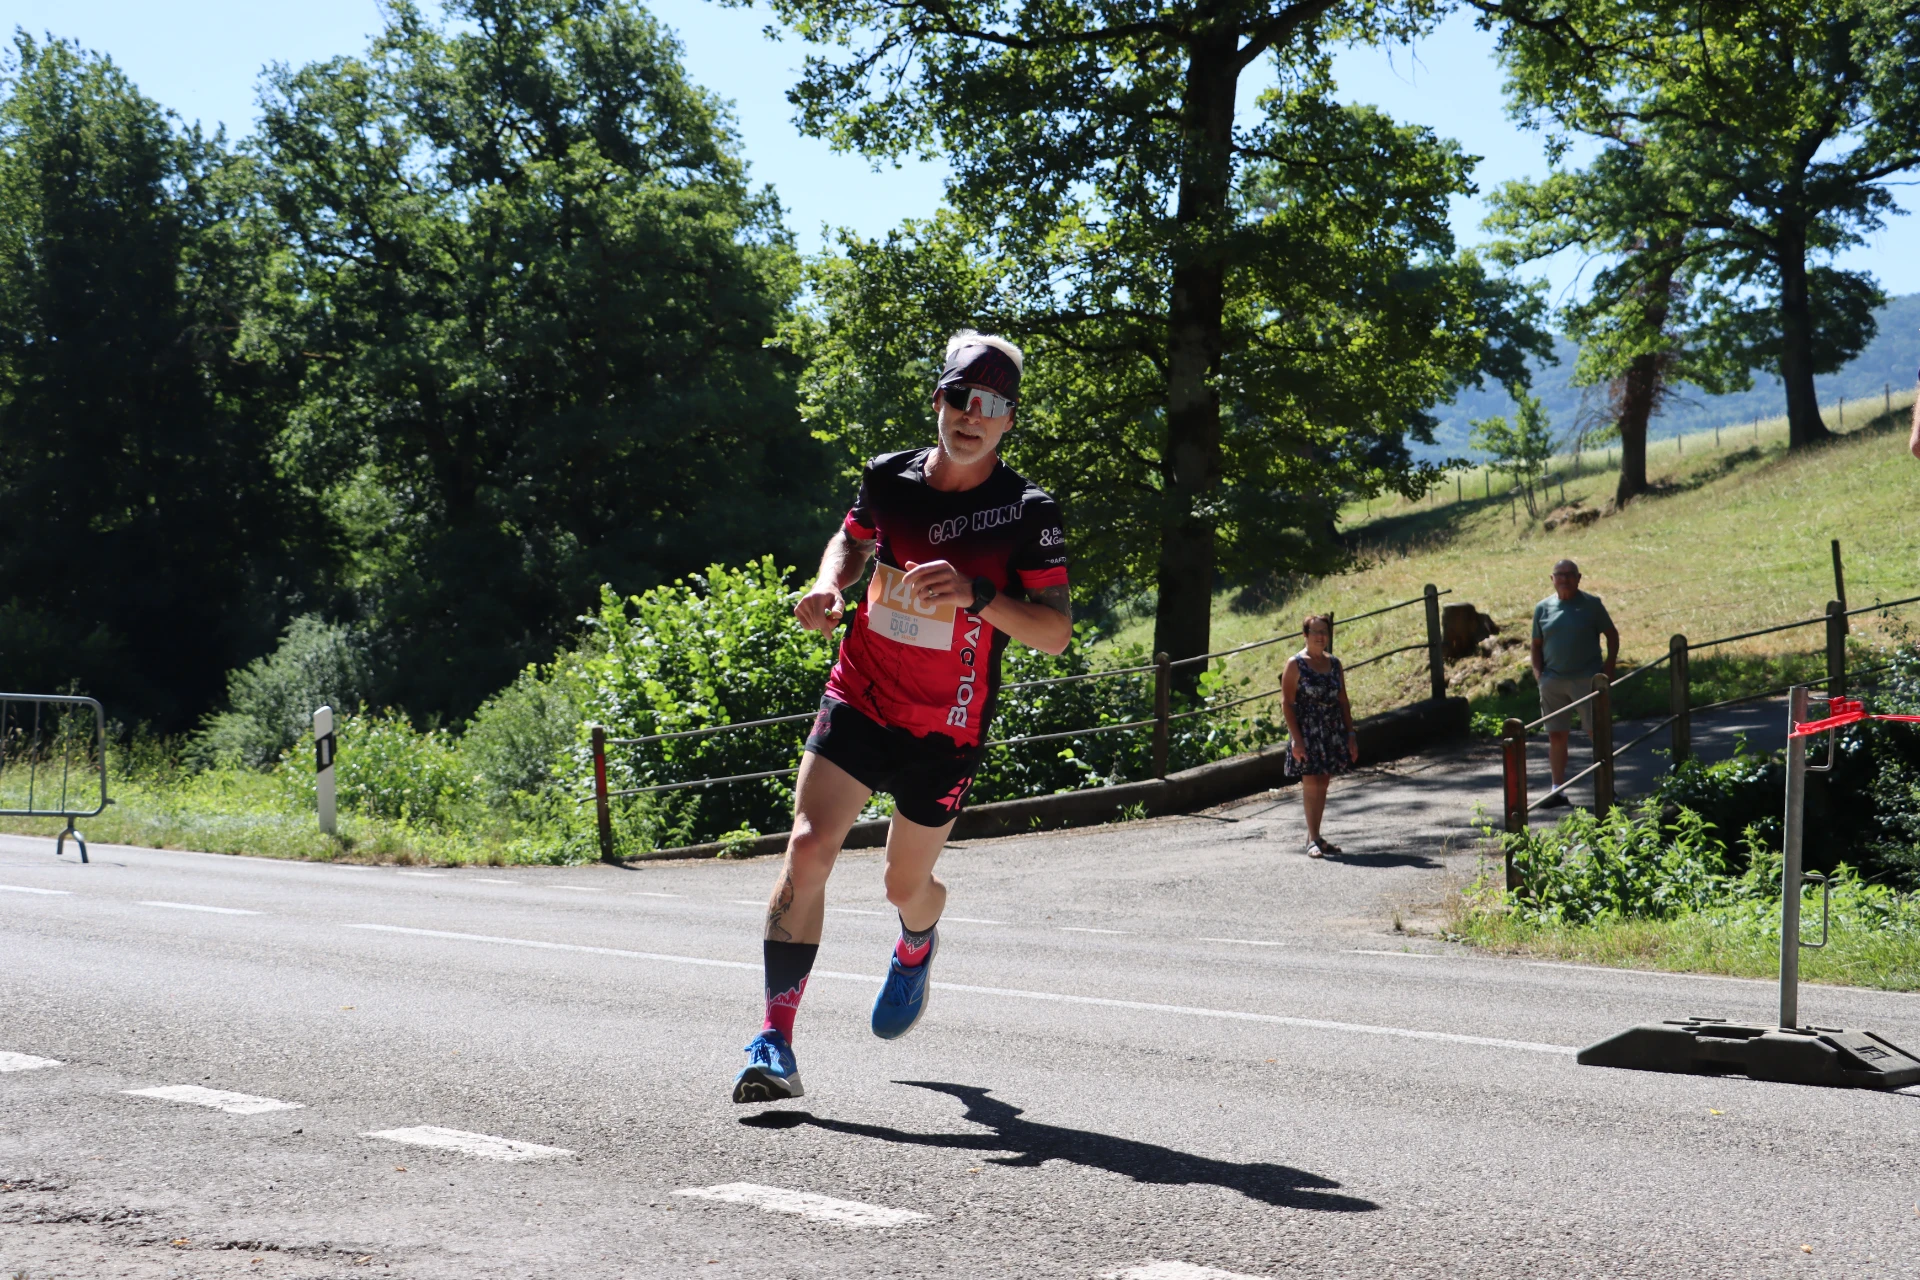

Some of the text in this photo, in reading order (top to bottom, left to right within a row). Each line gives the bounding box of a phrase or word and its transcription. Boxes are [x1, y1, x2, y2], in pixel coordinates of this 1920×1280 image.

[929, 500, 1025, 545] CAP HUNT
[890, 617, 918, 636] DUO
